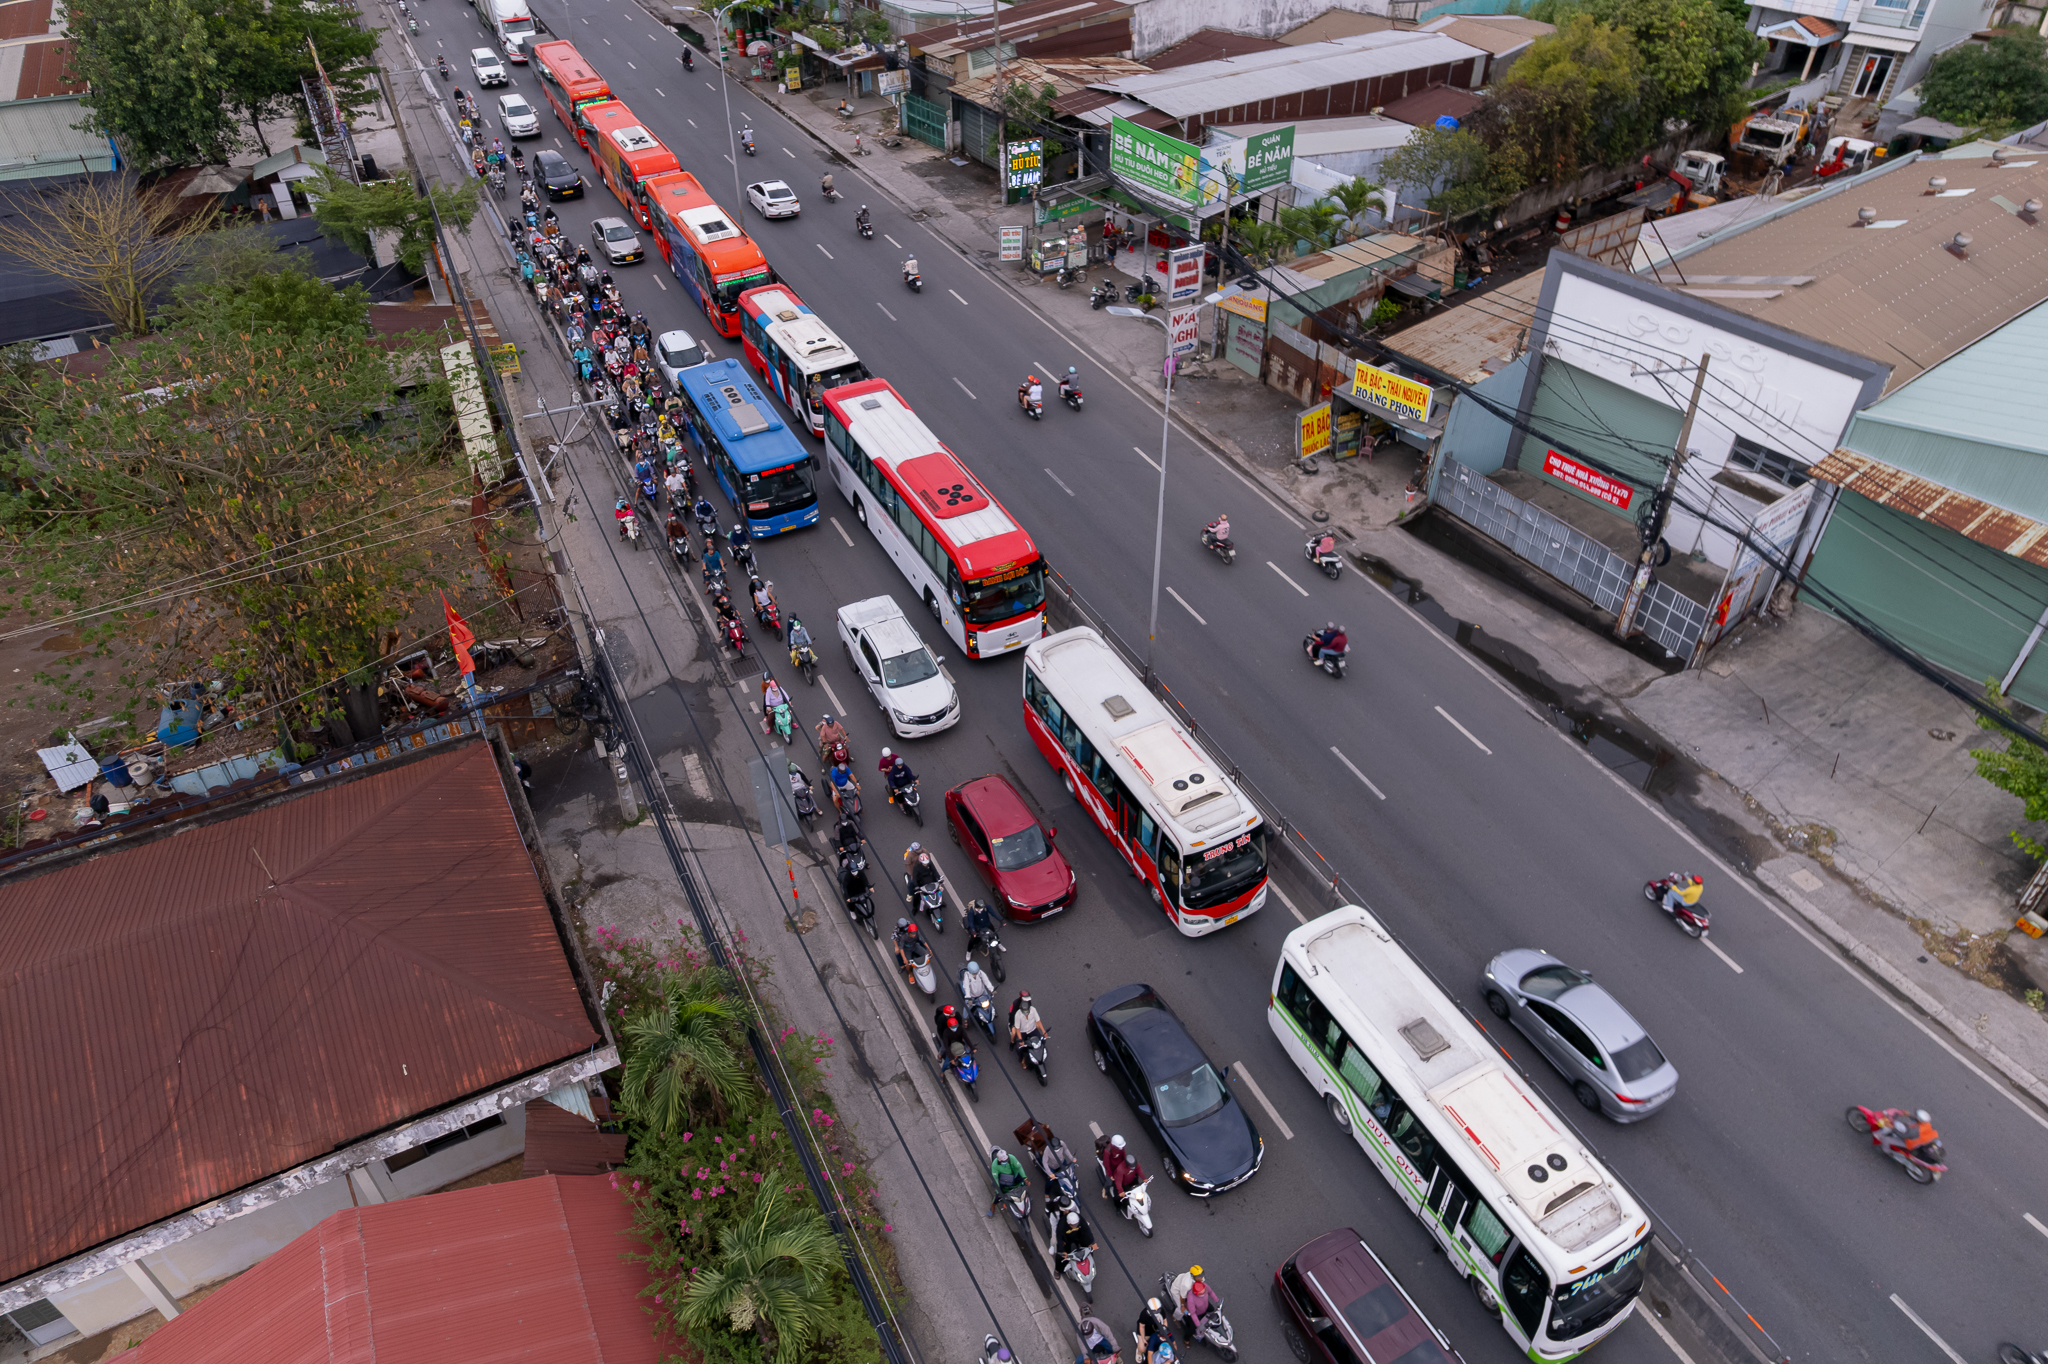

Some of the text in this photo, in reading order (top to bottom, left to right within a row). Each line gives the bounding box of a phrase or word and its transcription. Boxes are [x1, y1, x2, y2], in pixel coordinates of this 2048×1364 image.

[1115, 133, 1169, 169] BÉ NĂM
[1261, 134, 1281, 147] QUÁN
[1248, 145, 1291, 169] BÉ NĂM
[1011, 170, 1021, 186] BÉ
[1154, 169, 1168, 181] HEO
[1177, 258, 1199, 274] NHÀ
[1356, 368, 1368, 385] TRÀ
[1369, 369, 1382, 390] BẮC
[1386, 379, 1400, 398] THÁI
[1401, 387, 1427, 408] NGUYÊN
[1355, 385, 1421, 420] HOÀNG PHONG
[1302, 408, 1330, 442] TRÀ BẮC
[1302, 441, 1319, 457] THUỐC
[1549, 455, 1561, 468] CHO
[1561, 461, 1576, 475] THUÊ
[1576, 468, 1589, 481] NHÀ
[1203, 833, 1251, 861] TRUNG TÍN
[1366, 1118, 1391, 1147] DUY
